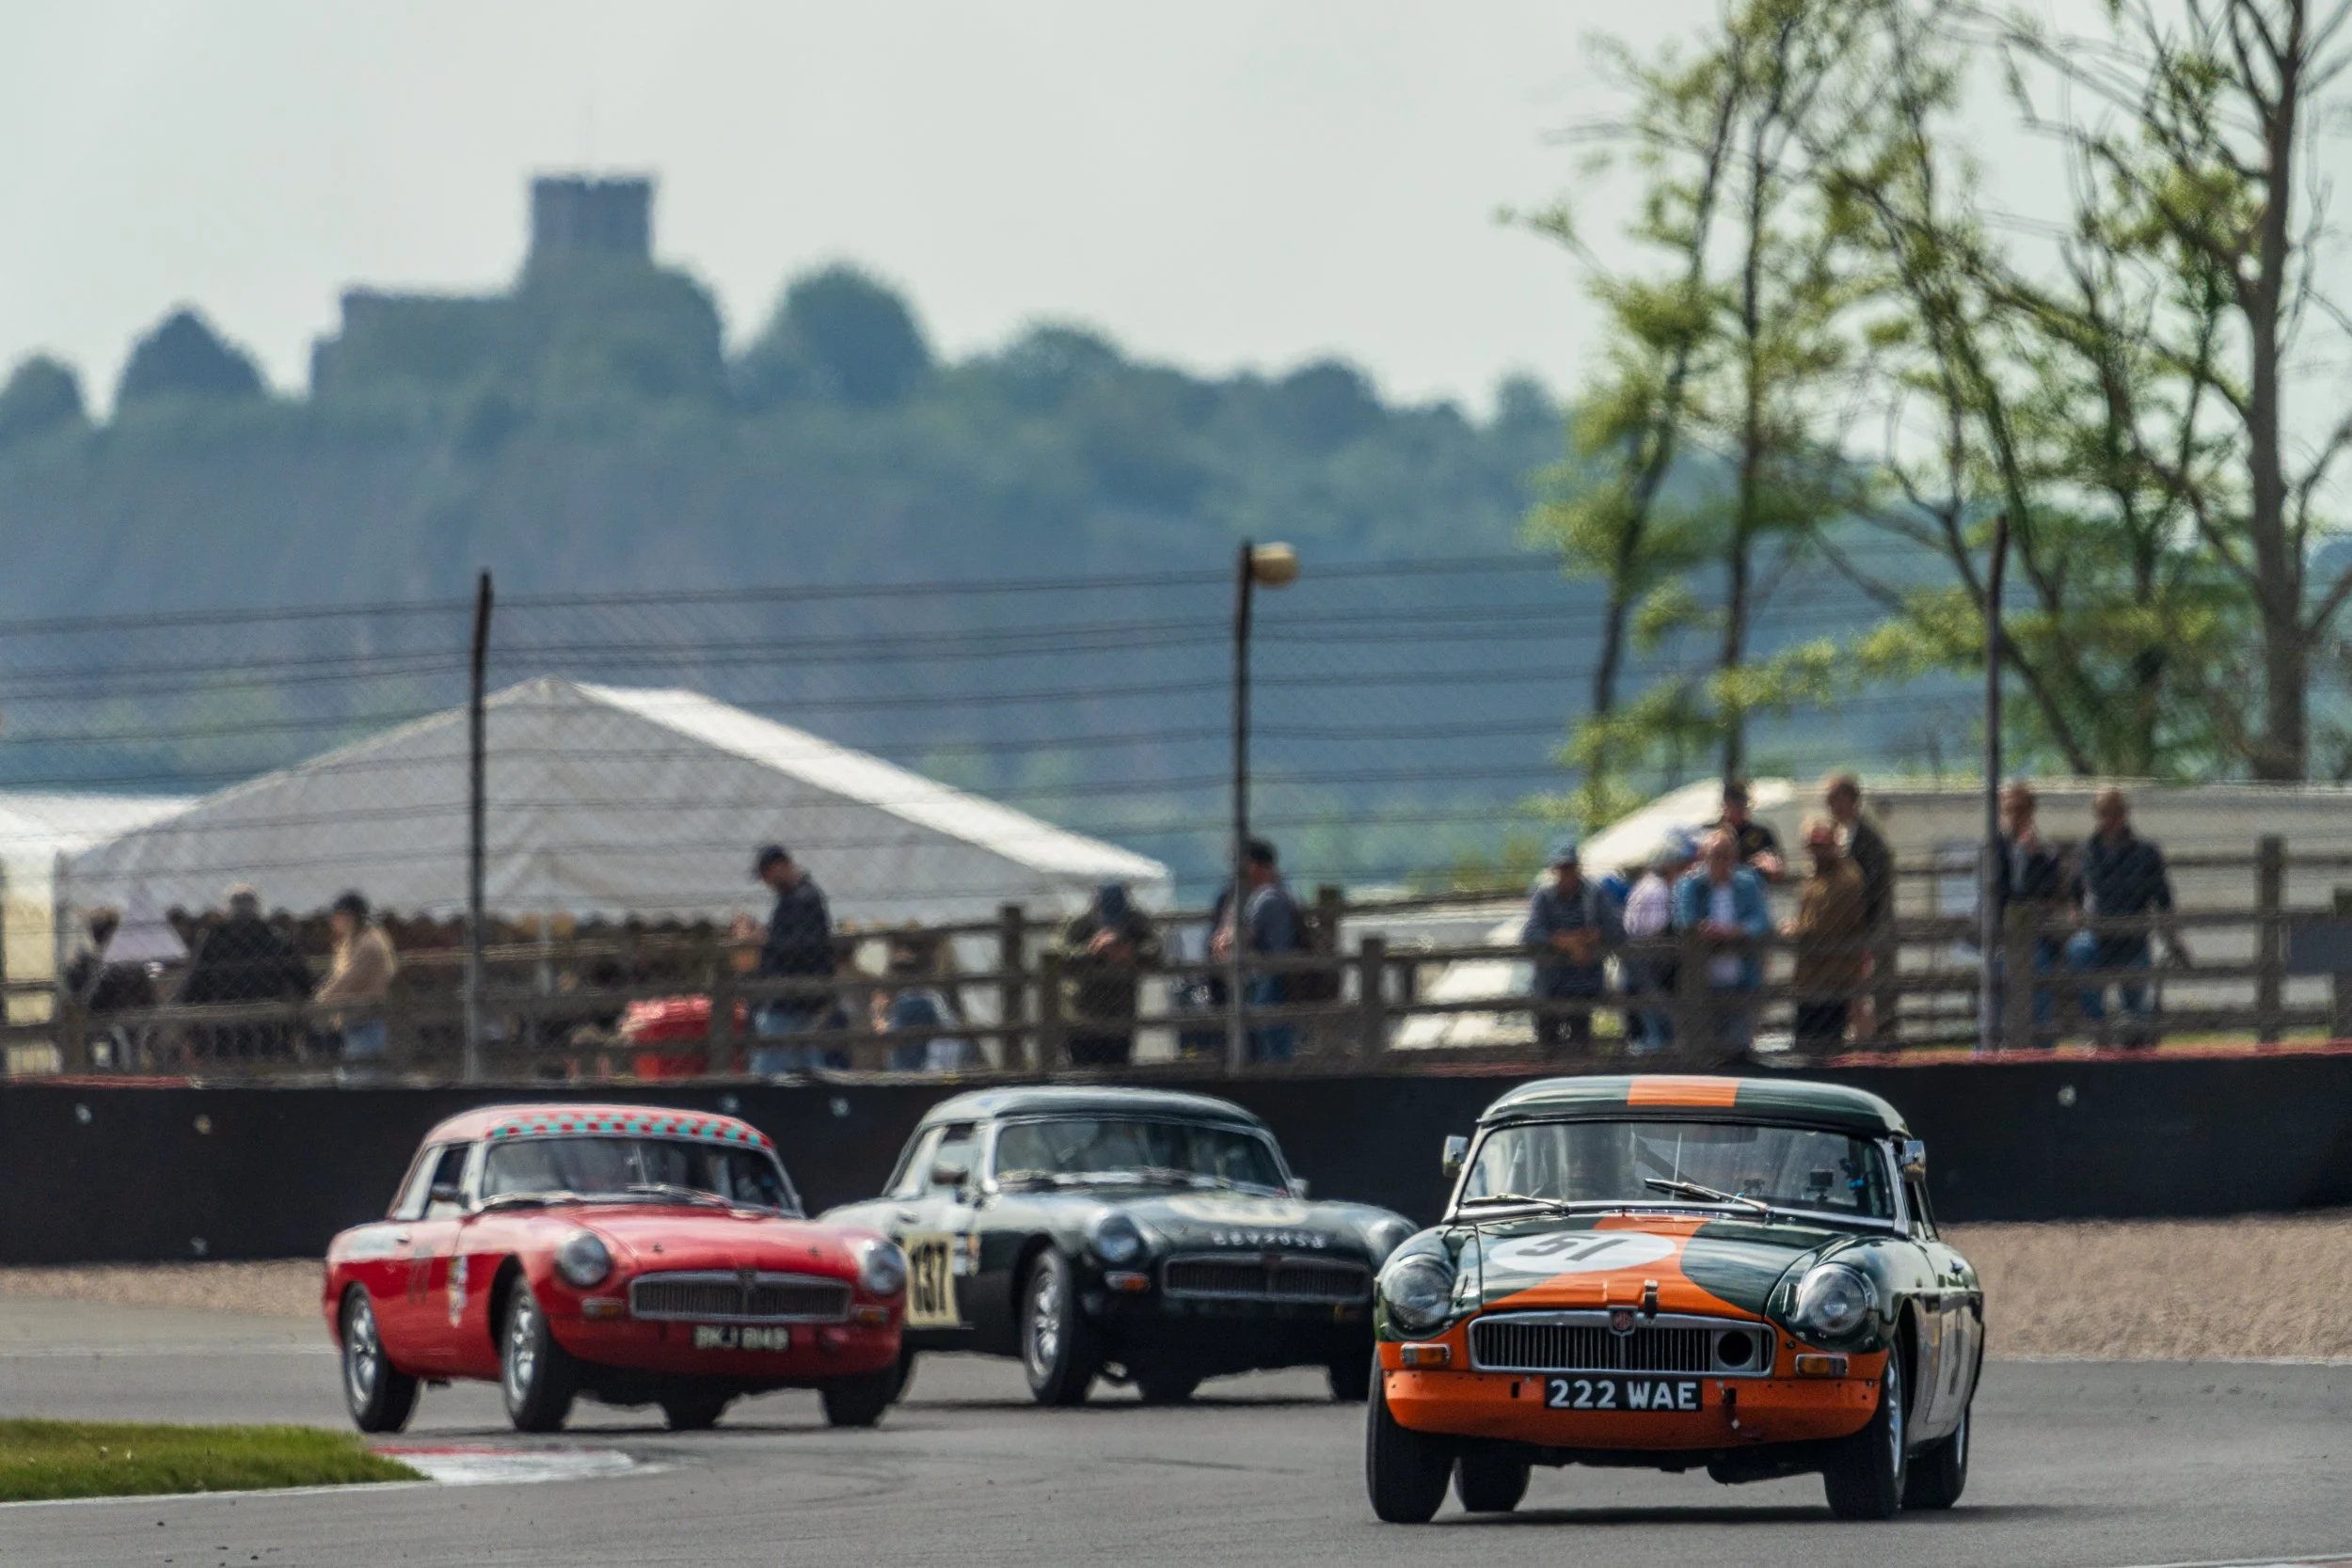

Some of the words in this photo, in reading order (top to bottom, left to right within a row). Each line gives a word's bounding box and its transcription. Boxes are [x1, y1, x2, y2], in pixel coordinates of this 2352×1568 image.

[1516, 1233, 1630, 1262] 51
[909, 1241, 948, 1314] 137
[1549, 1378, 1617, 1409] 222
[1627, 1380, 1698, 1411] WAE
